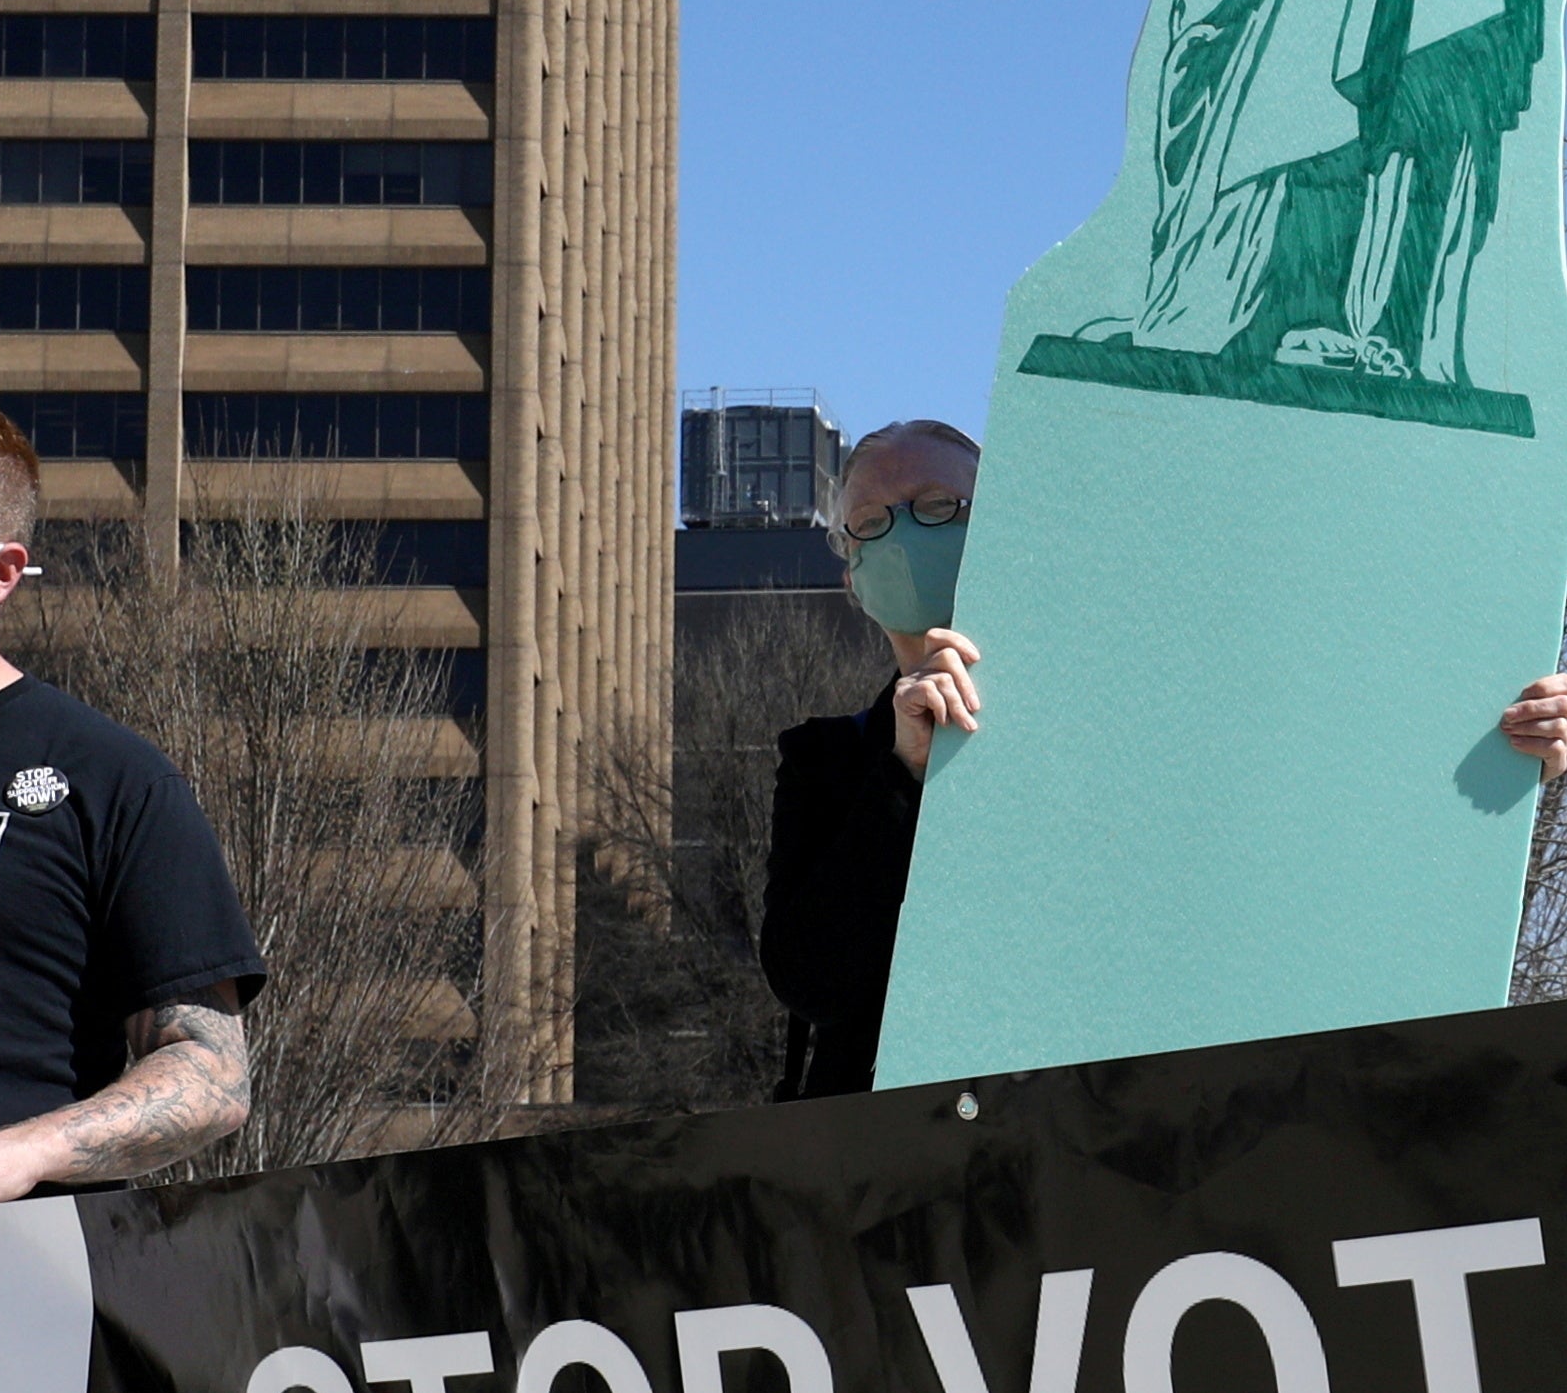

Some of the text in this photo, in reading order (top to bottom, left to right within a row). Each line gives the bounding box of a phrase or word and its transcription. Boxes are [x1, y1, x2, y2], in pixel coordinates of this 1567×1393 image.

[12, 776, 57, 789] VOTER
[16, 767, 53, 783] STOP
[17, 790, 56, 807] NOW!
